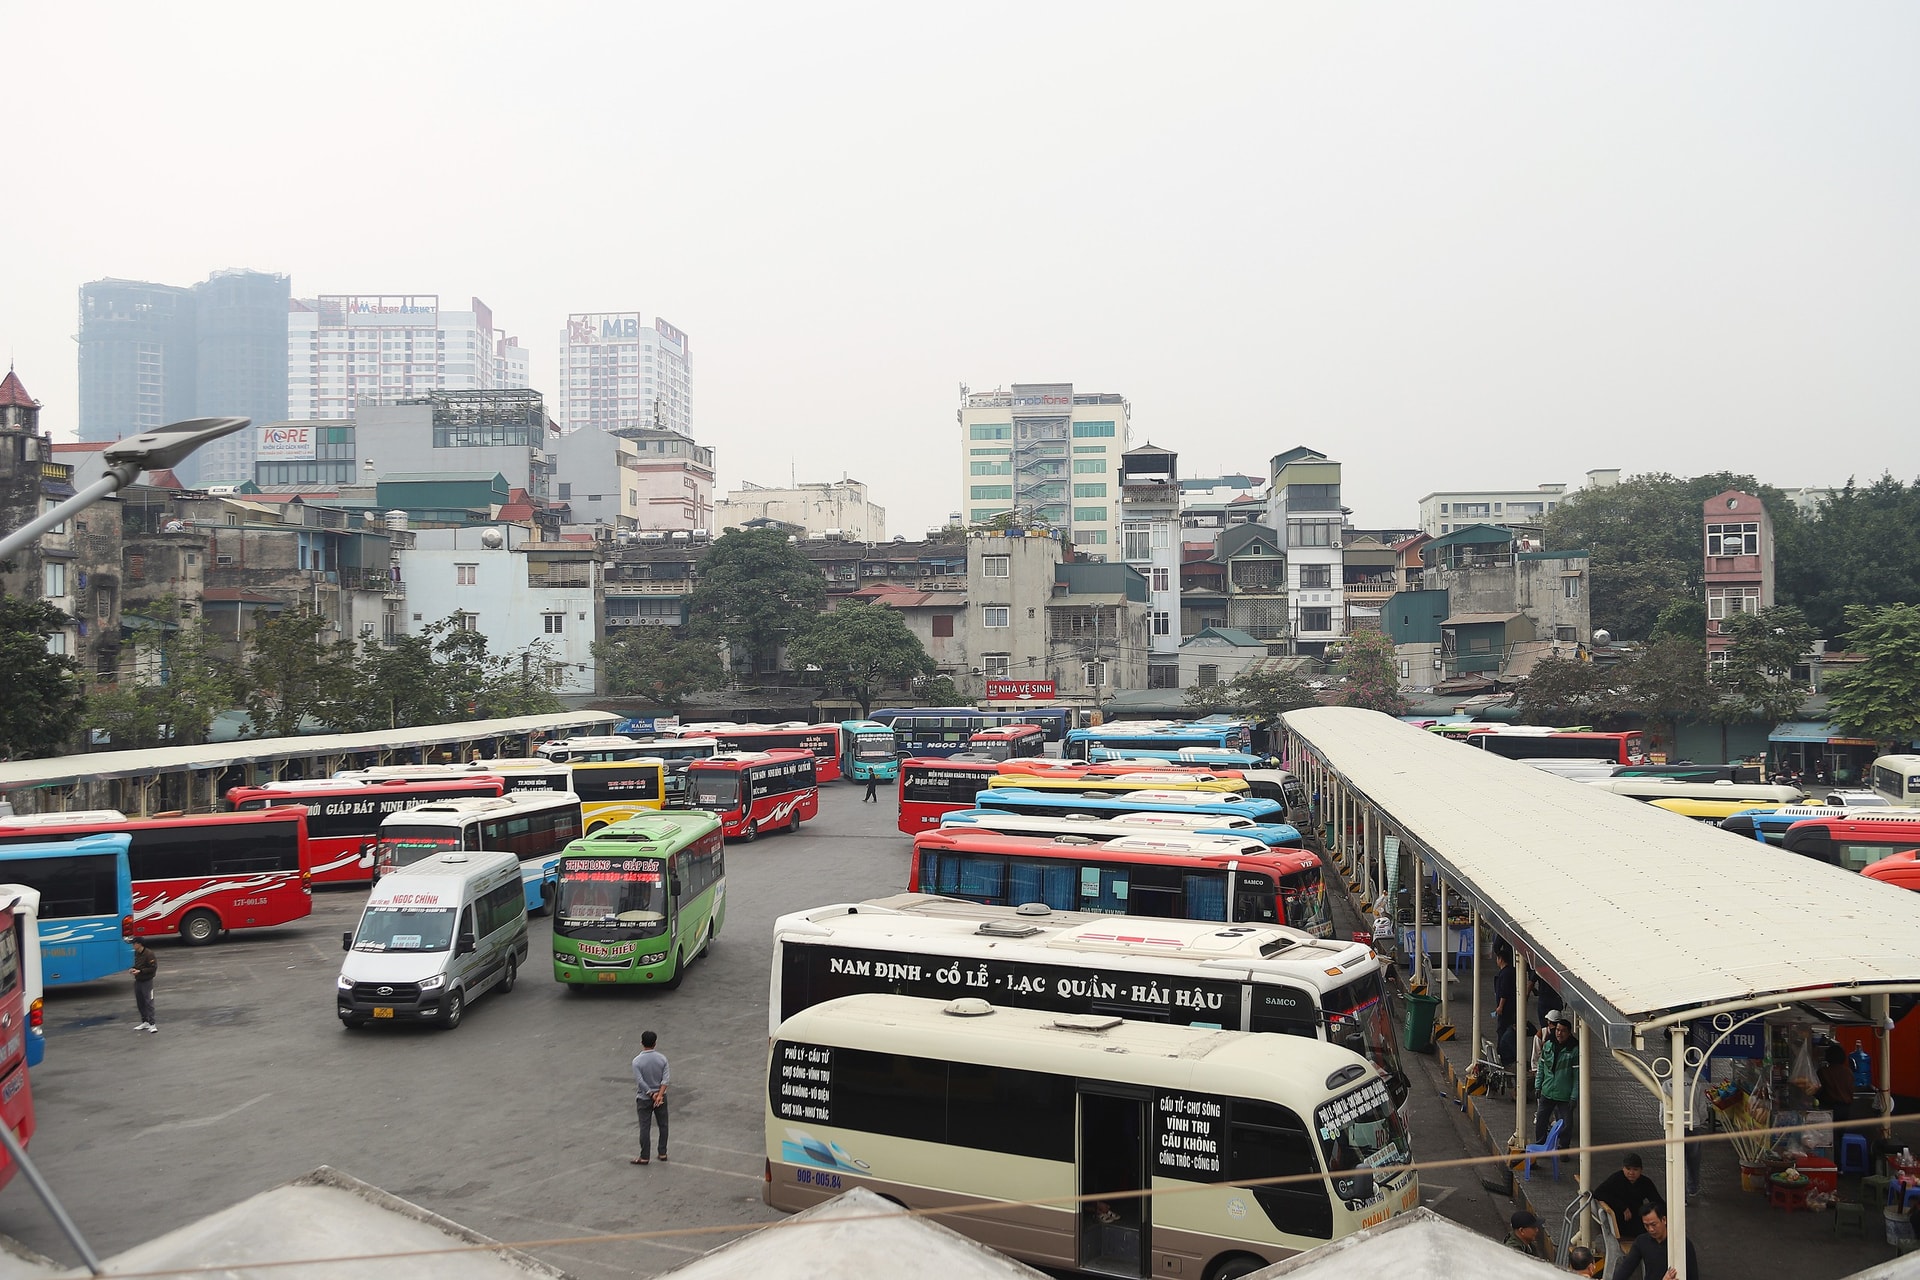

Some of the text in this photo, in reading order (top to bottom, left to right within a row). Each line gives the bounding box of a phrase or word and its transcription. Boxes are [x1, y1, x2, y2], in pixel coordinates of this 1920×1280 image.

[603, 319, 638, 337] MB
[1014, 395, 1068, 406] mobifone
[264, 429, 308, 442] KORE
[999, 682, 1052, 695] NHÀ VỆ SINH
[326, 801, 350, 815] GIÁP
[353, 800, 375, 814] BÁT
[380, 800, 403, 812] NINH
[566, 858, 659, 872] THỊNH LONG GIÁP BÁT
[392, 895, 413, 905] NGỌC
[415, 892, 439, 904] CHÍNH
[578, 941, 637, 955] THIÊN HIẾU
[830, 958, 870, 976] NAM
[875, 962, 922, 982] ĐỊNH
[936, 961, 961, 984] CỔ
[966, 964, 989, 987] LỄ
[1007, 974, 1045, 995] LẠC
[1057, 974, 1116, 999] QUẦN
[1131, 981, 1170, 1004] HẢI
[1175, 988, 1223, 1011] HẬU
[1266, 998, 1296, 1006] SAMCO
[1734, 1034, 1755, 1048] TRỤ
[1187, 1102, 1201, 1118] CHỢ
[1167, 1115, 1210, 1137] VĨNH TRỤ
[1183, 1136, 1216, 1153] KHÔNG
[1176, 1152, 1190, 1168] TRÓC
[1194, 1154, 1210, 1170] CỐNG
[1211, 1155, 1220, 1172] ĐỎ
[797, 1169, 841, 1189] 90B-005.84
[1362, 1212, 1382, 1229] CHÂN
